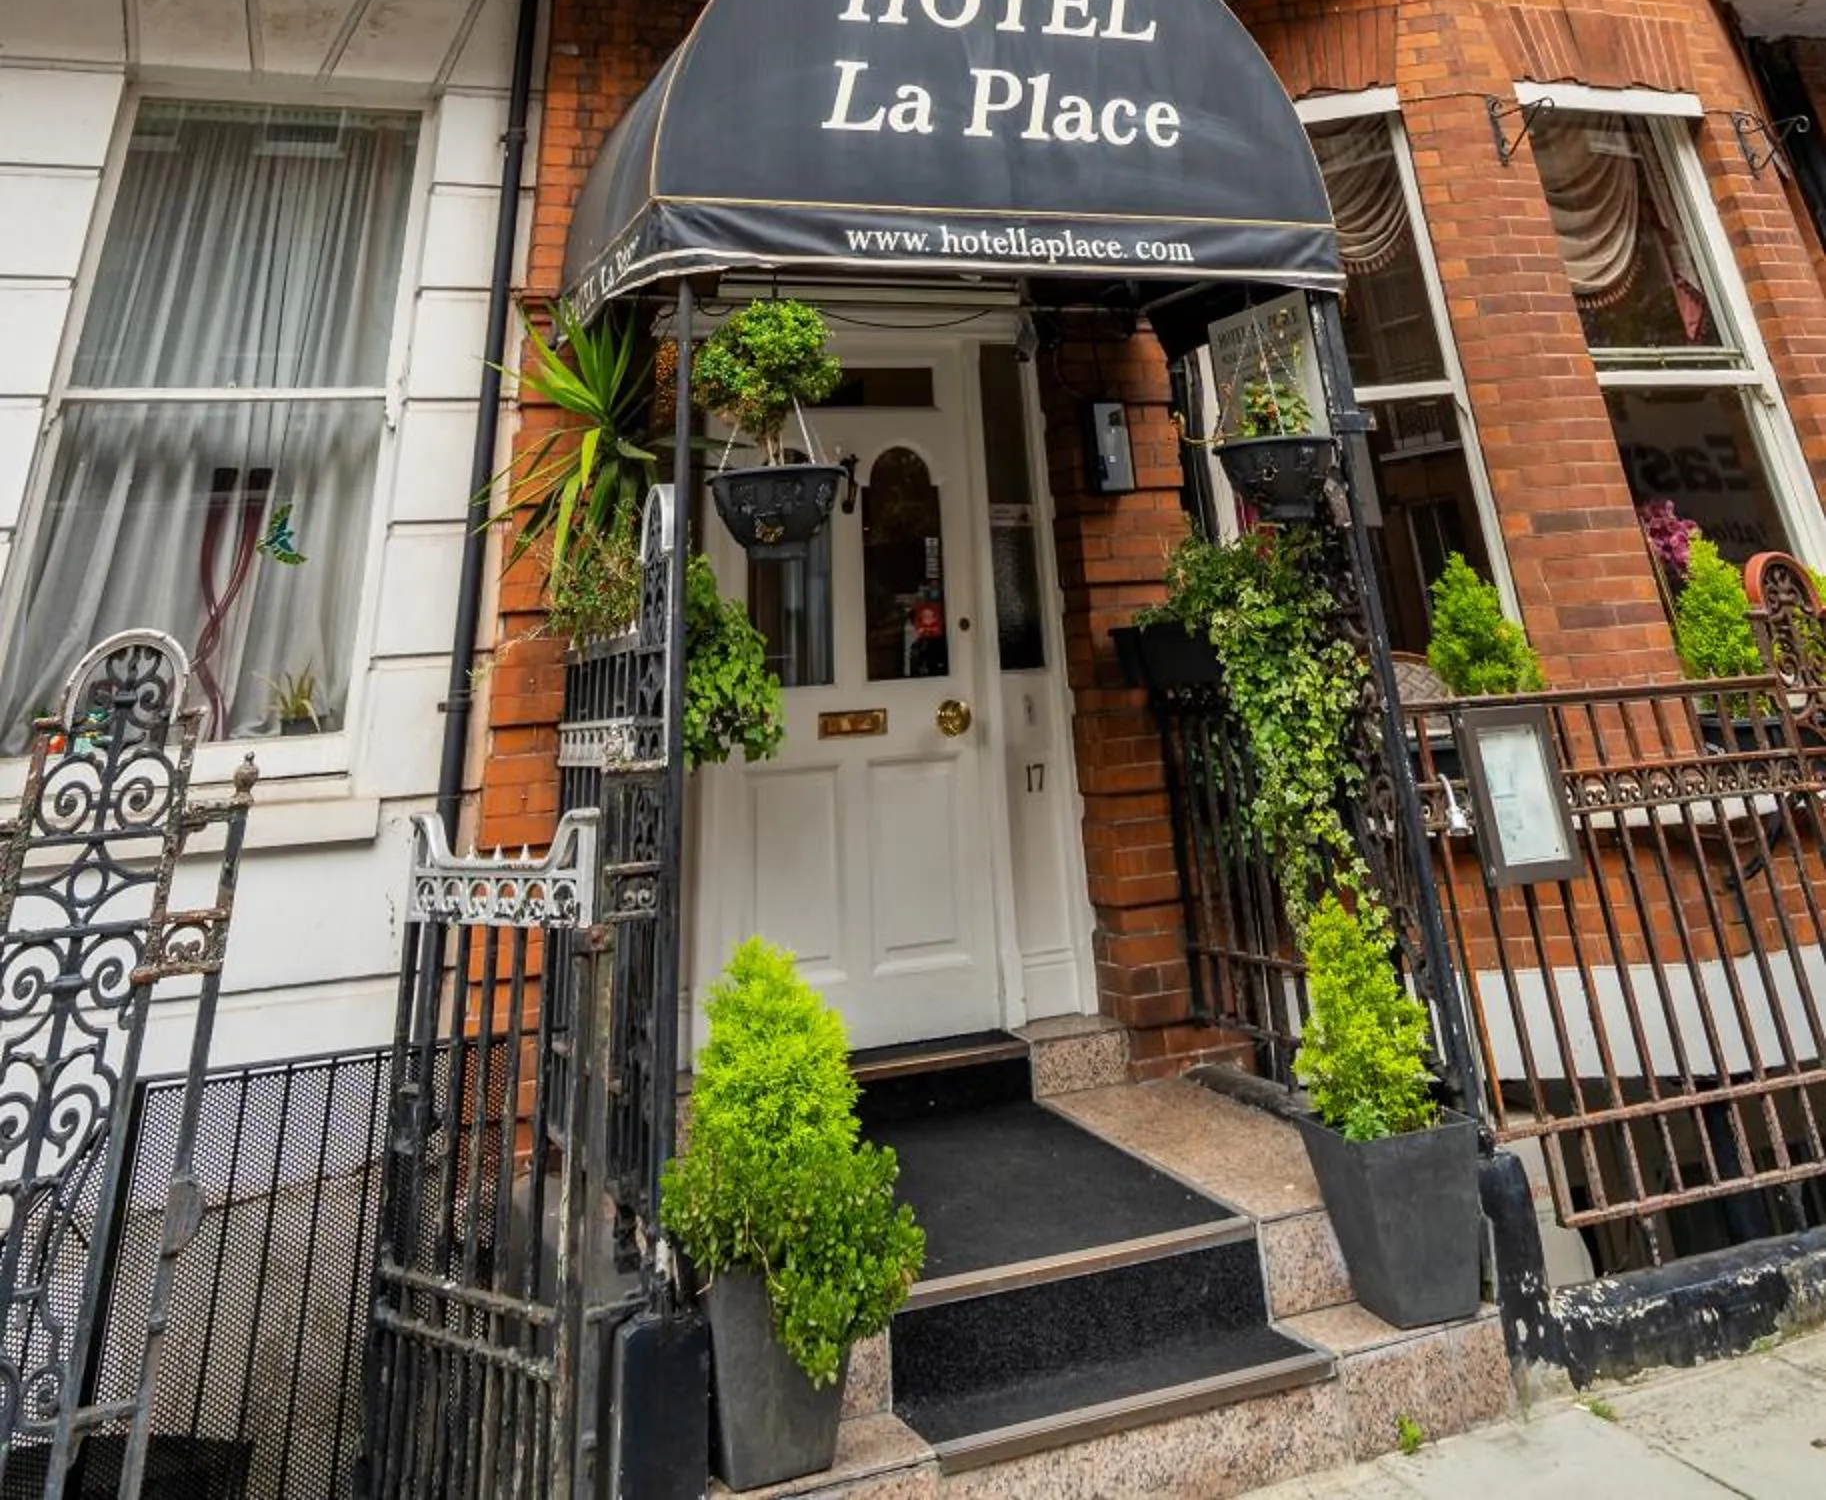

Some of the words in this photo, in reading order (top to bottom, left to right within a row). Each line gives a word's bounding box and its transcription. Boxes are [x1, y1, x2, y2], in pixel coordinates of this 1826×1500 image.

[821, 60, 933, 134] La
[963, 68, 1181, 147] Place
[1135, 239, 1195, 261] com
[1025, 763, 1045, 793] 17
